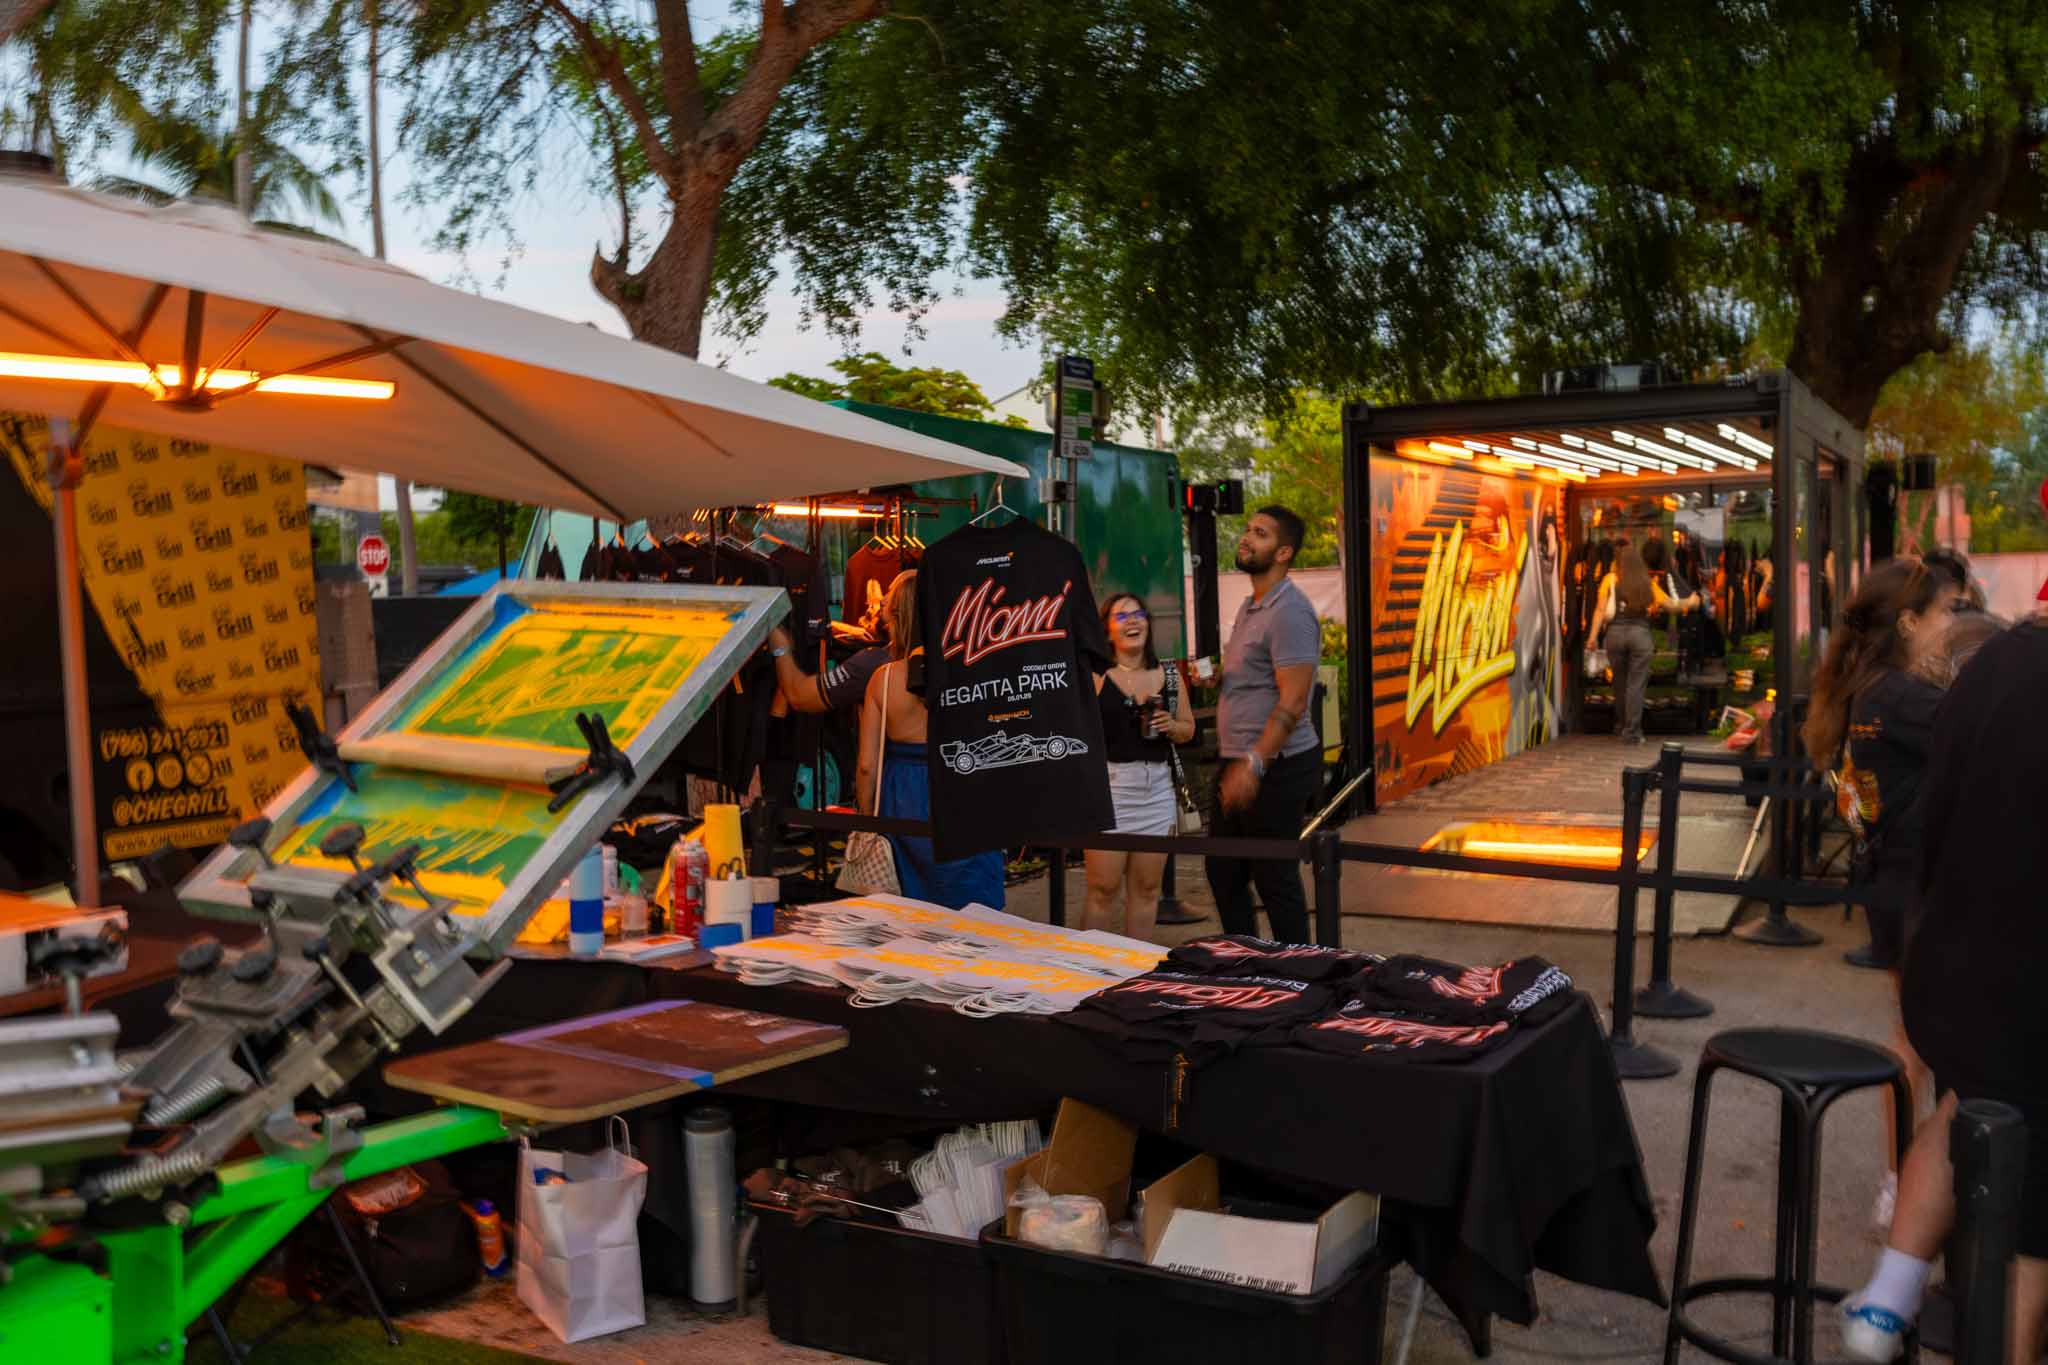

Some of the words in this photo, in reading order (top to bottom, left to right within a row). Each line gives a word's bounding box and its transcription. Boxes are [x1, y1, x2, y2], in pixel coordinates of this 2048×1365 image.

[195, 527, 232, 551] Grill
[104, 549, 144, 575] Grill
[360, 547, 387, 566] STOP
[244, 559, 279, 583] Grill
[157, 580, 196, 607] Grill
[217, 613, 254, 639] Grill
[265, 647, 299, 671] Grill
[1047, 661, 1067, 671] GROVE
[1017, 670, 1068, 693] PARK
[112, 786, 229, 826] @CHEGRILL
